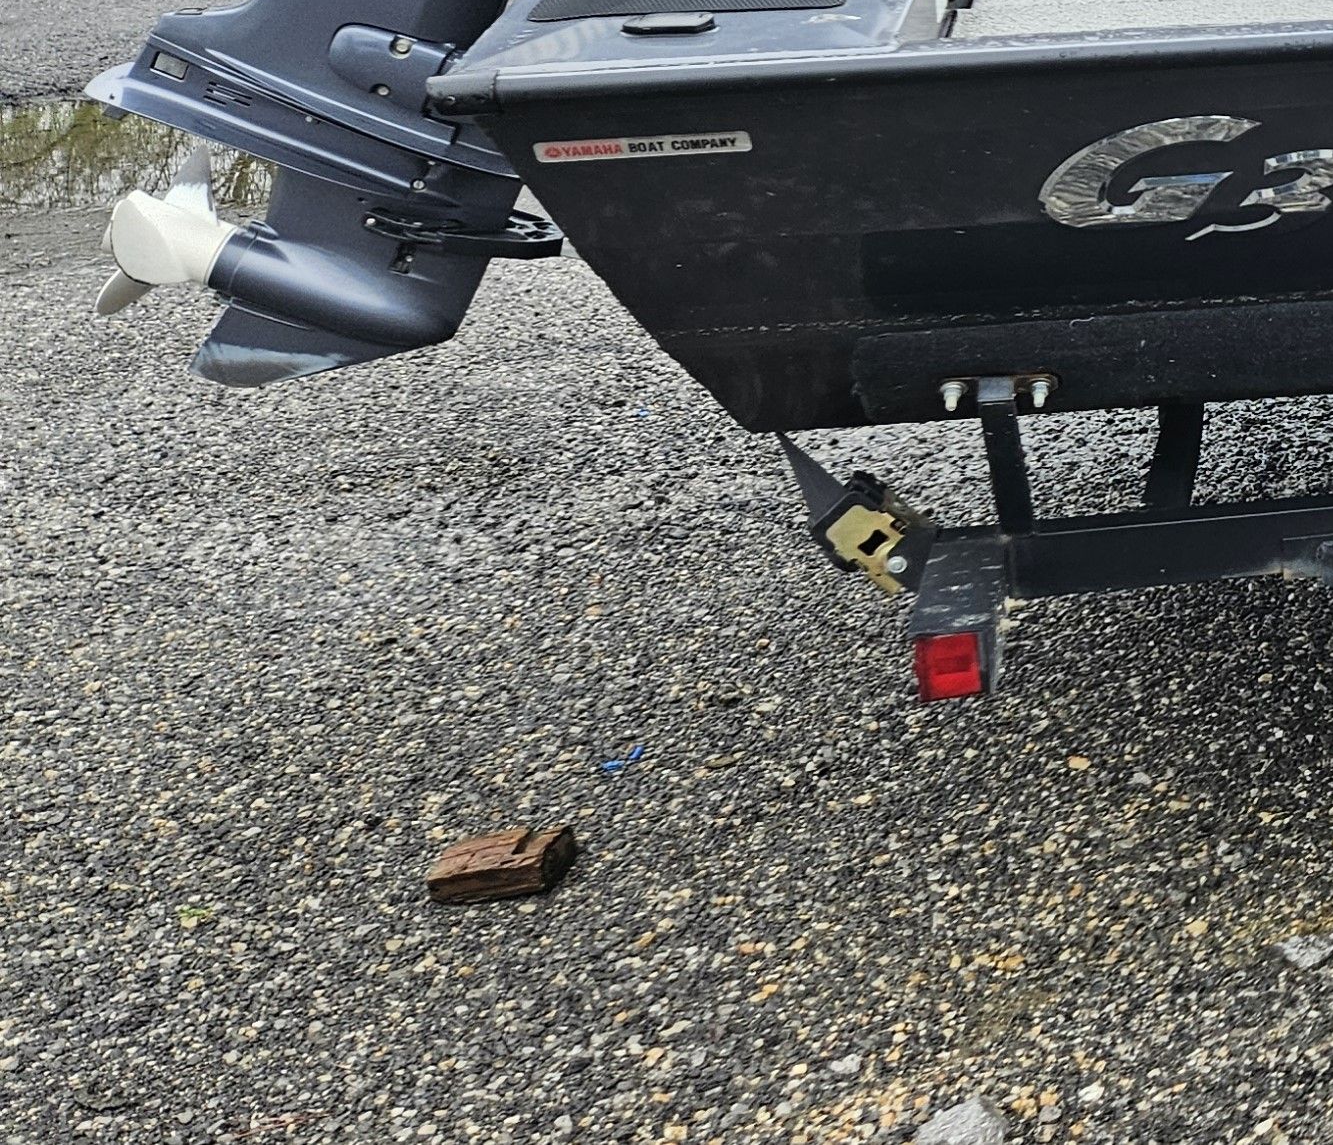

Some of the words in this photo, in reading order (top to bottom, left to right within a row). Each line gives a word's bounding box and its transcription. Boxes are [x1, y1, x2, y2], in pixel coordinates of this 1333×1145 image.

[562, 143, 623, 157] YAMAHA
[629, 141, 665, 153] BOAT
[671, 137, 737, 151] COMPANY
